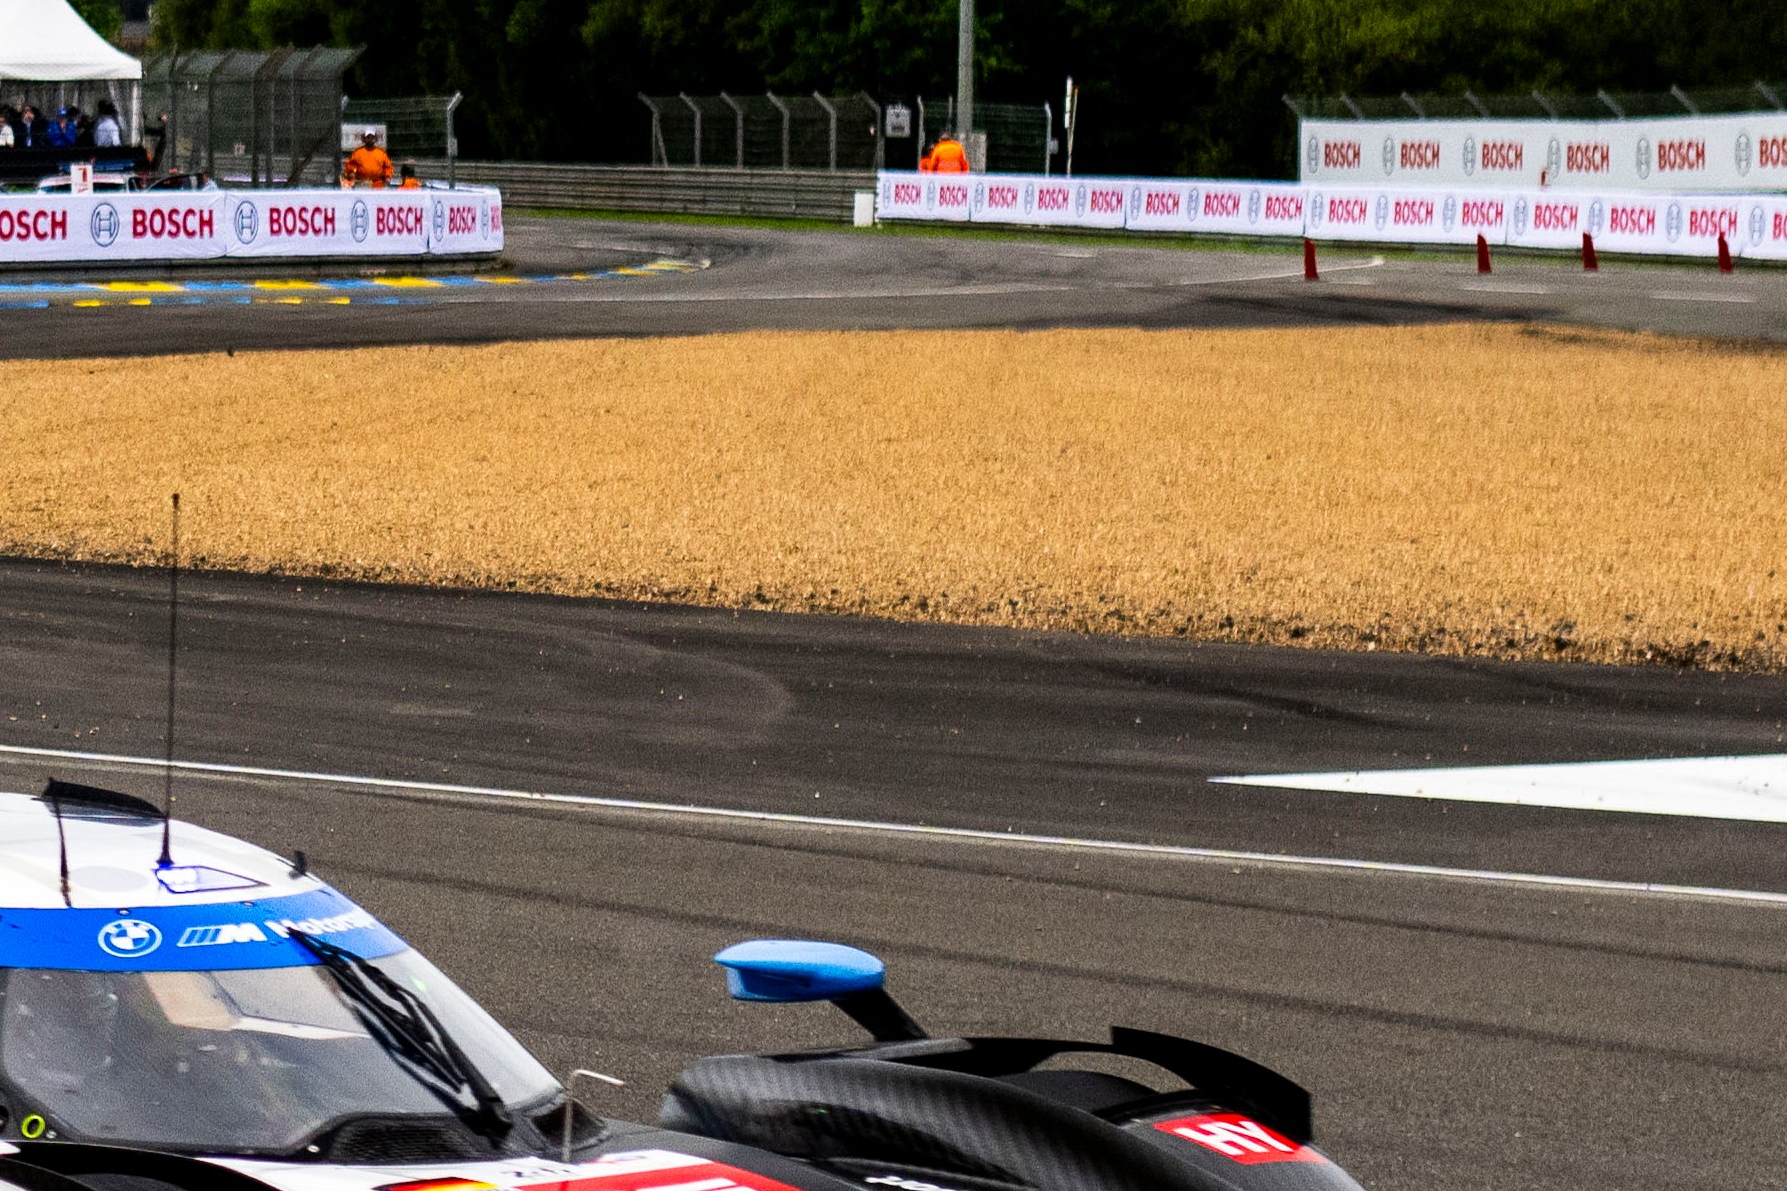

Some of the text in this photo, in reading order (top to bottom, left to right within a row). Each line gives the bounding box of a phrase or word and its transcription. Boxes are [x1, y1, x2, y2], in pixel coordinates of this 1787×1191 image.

[1324, 142, 1361, 168] BOSCH
[1400, 143, 1440, 168] BOSCH
[1482, 143, 1523, 169] BOSCH
[1567, 144, 1610, 172] BOSCH
[1658, 141, 1706, 171] BOSCH
[894, 183, 922, 205] BOSCH
[938, 185, 968, 207] BOSCH
[988, 185, 1018, 208] BOSCH
[1038, 186, 1069, 210] BOSCH
[1090, 189, 1124, 213] BOSCH
[1145, 191, 1180, 215] BOSCH
[1203, 191, 1241, 218] BOSCH
[1264, 194, 1303, 220] BOSCH
[131, 207, 214, 240] BOSCH
[268, 206, 336, 237] BOSCH
[376, 206, 423, 236] BOSCH
[448, 206, 477, 235] BOSCH
[1328, 197, 1368, 225] BOSCH
[1393, 199, 1434, 226] BOSCH
[1461, 200, 1505, 227] BOSCH
[1533, 202, 1579, 231] BOSCH
[1609, 205, 1656, 235] BOSCH
[1688, 207, 1738, 236] BOSCH
[1173, 1119, 1294, 1156] HY
